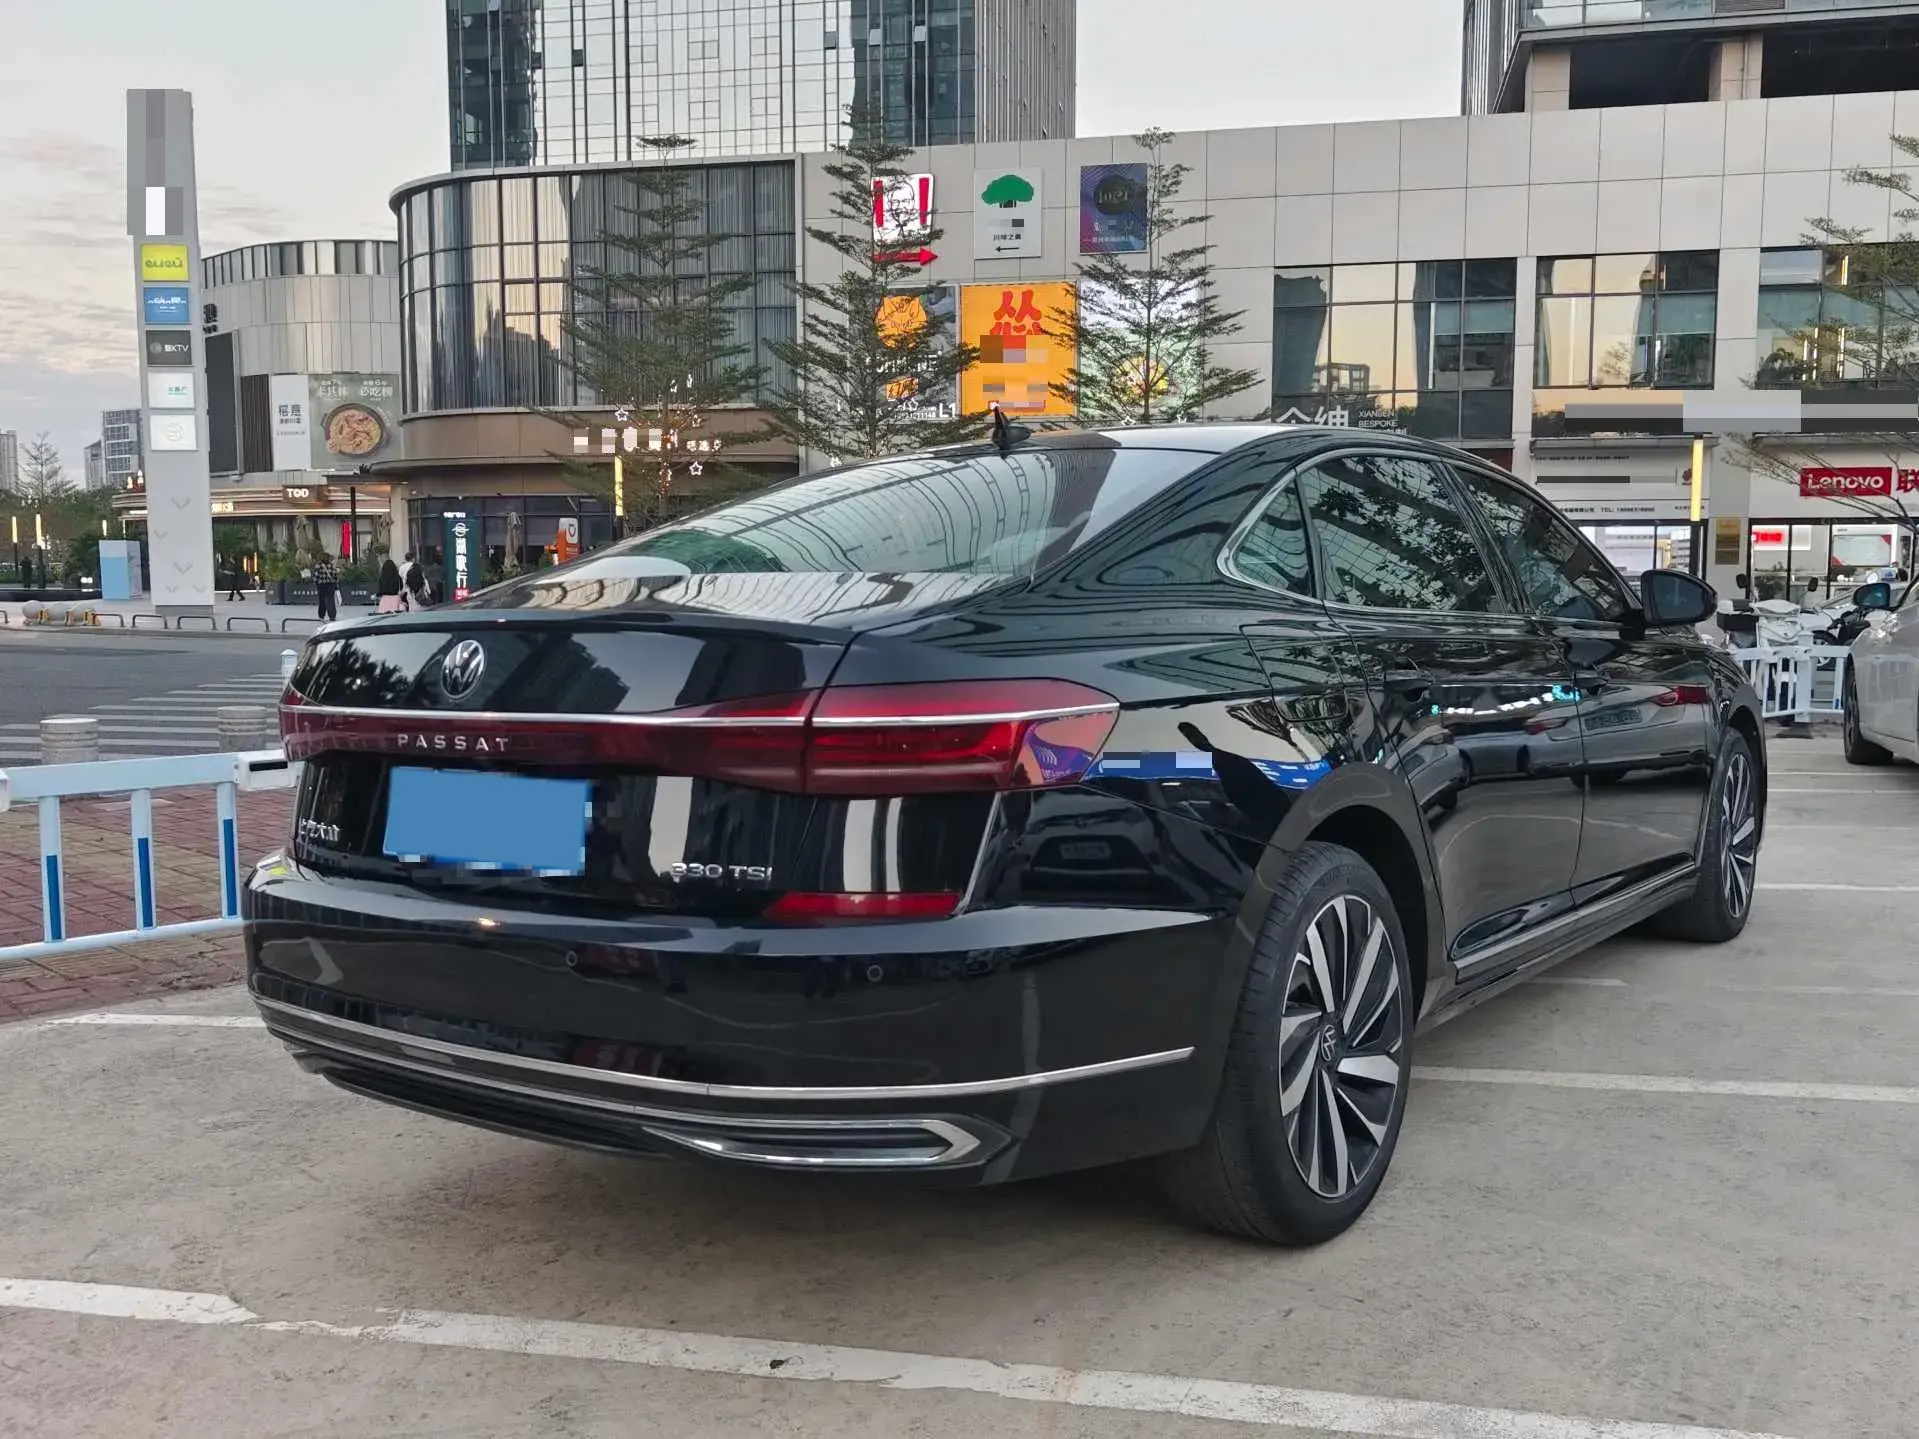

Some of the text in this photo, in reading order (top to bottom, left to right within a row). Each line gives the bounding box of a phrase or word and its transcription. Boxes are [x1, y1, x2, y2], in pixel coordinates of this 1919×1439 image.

[1358, 420, 1399, 428] BESPOKE
[1807, 473, 1885, 490] Lenovo
[397, 733, 509, 752] PASSAT
[728, 865, 773, 881] TSI
